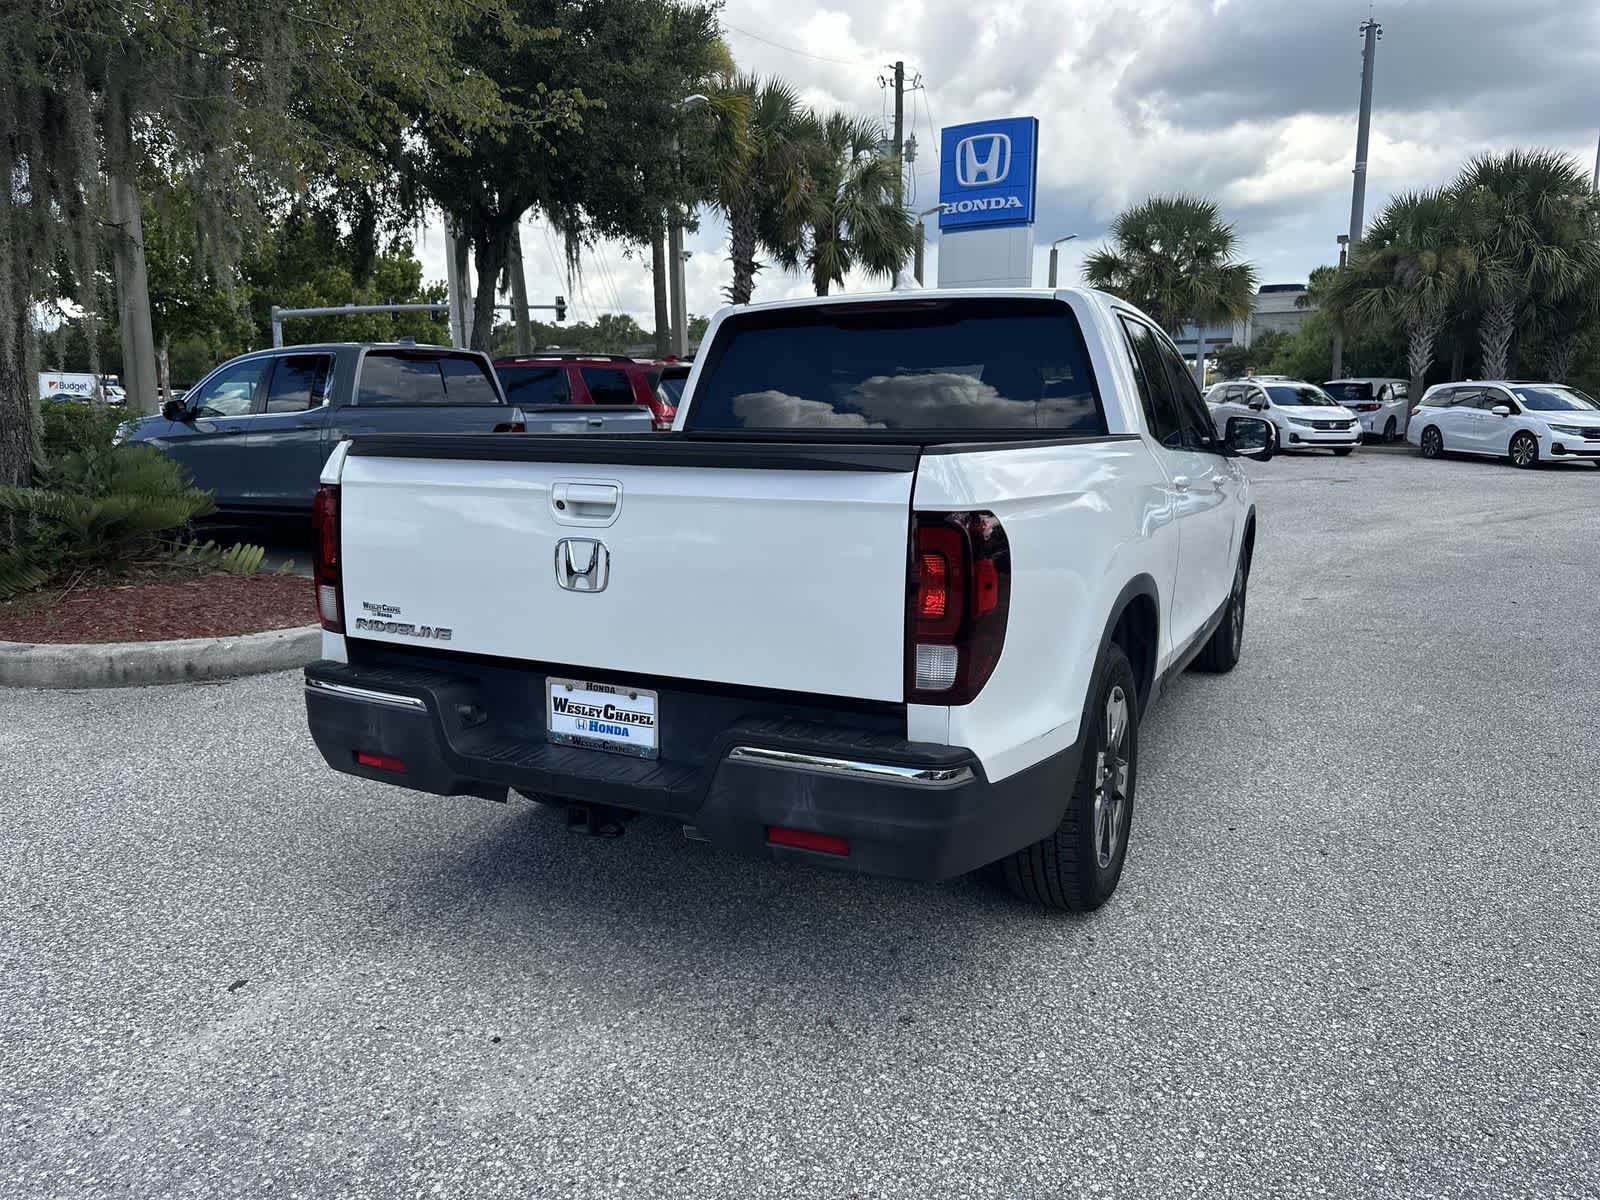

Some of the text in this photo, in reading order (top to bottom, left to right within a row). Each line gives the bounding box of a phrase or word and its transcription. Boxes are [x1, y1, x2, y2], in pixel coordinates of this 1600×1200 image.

[942, 196, 1023, 215] HONDA
[59, 381, 87, 392] Budget
[356, 618, 452, 640] RIDGELINE
